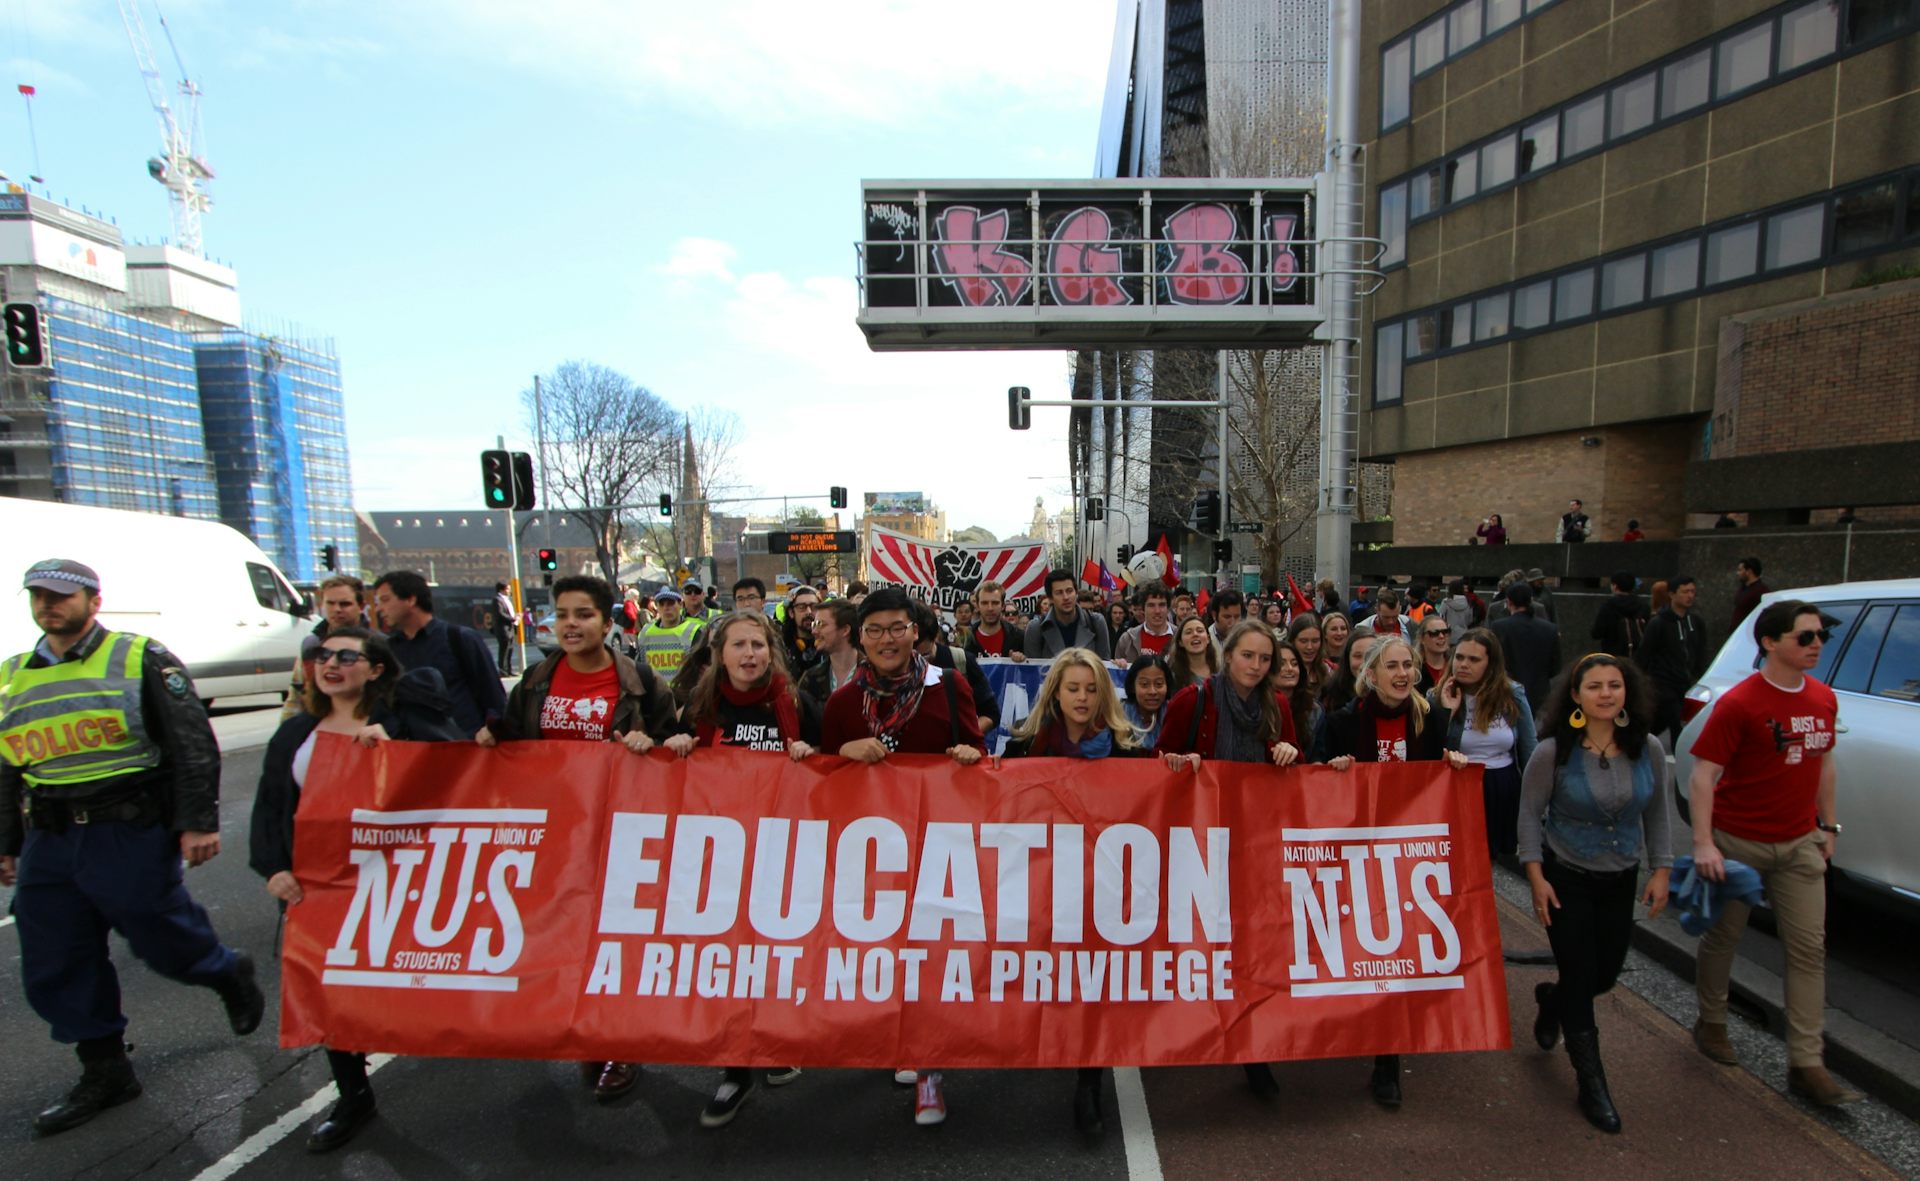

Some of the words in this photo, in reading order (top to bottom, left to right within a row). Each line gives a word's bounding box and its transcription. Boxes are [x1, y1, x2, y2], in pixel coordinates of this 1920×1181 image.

[800, 533, 813, 541] NOT
[815, 533, 835, 541] QUEUE
[540, 719, 605, 733] EDUCATION
[735, 723, 767, 741] BUST
[767, 727, 779, 739] THE
[1791, 715, 1815, 733] BUST
[6, 716, 128, 764] POLICE
[584, 732, 604, 740] 2014
[352, 827, 424, 845] NATIONAL
[493, 828, 527, 846] UNION
[529, 828, 545, 845] OF
[1283, 845, 1338, 863] NATIONAL
[1403, 841, 1437, 858] UNION
[1439, 840, 1451, 857] OF
[598, 811, 1233, 945] EDUCATION
[393, 950, 462, 970] STUDENTS
[1353, 958, 1416, 978] STUDENTS
[410, 975, 427, 987] INC
[585, 941, 622, 995] A
[636, 942, 808, 1007] RIGHT,
[823, 947, 928, 1003] NOT
[940, 948, 974, 1002] A
[989, 949, 1235, 1003] PRIVILEGE
[1374, 980, 1391, 993] INC
